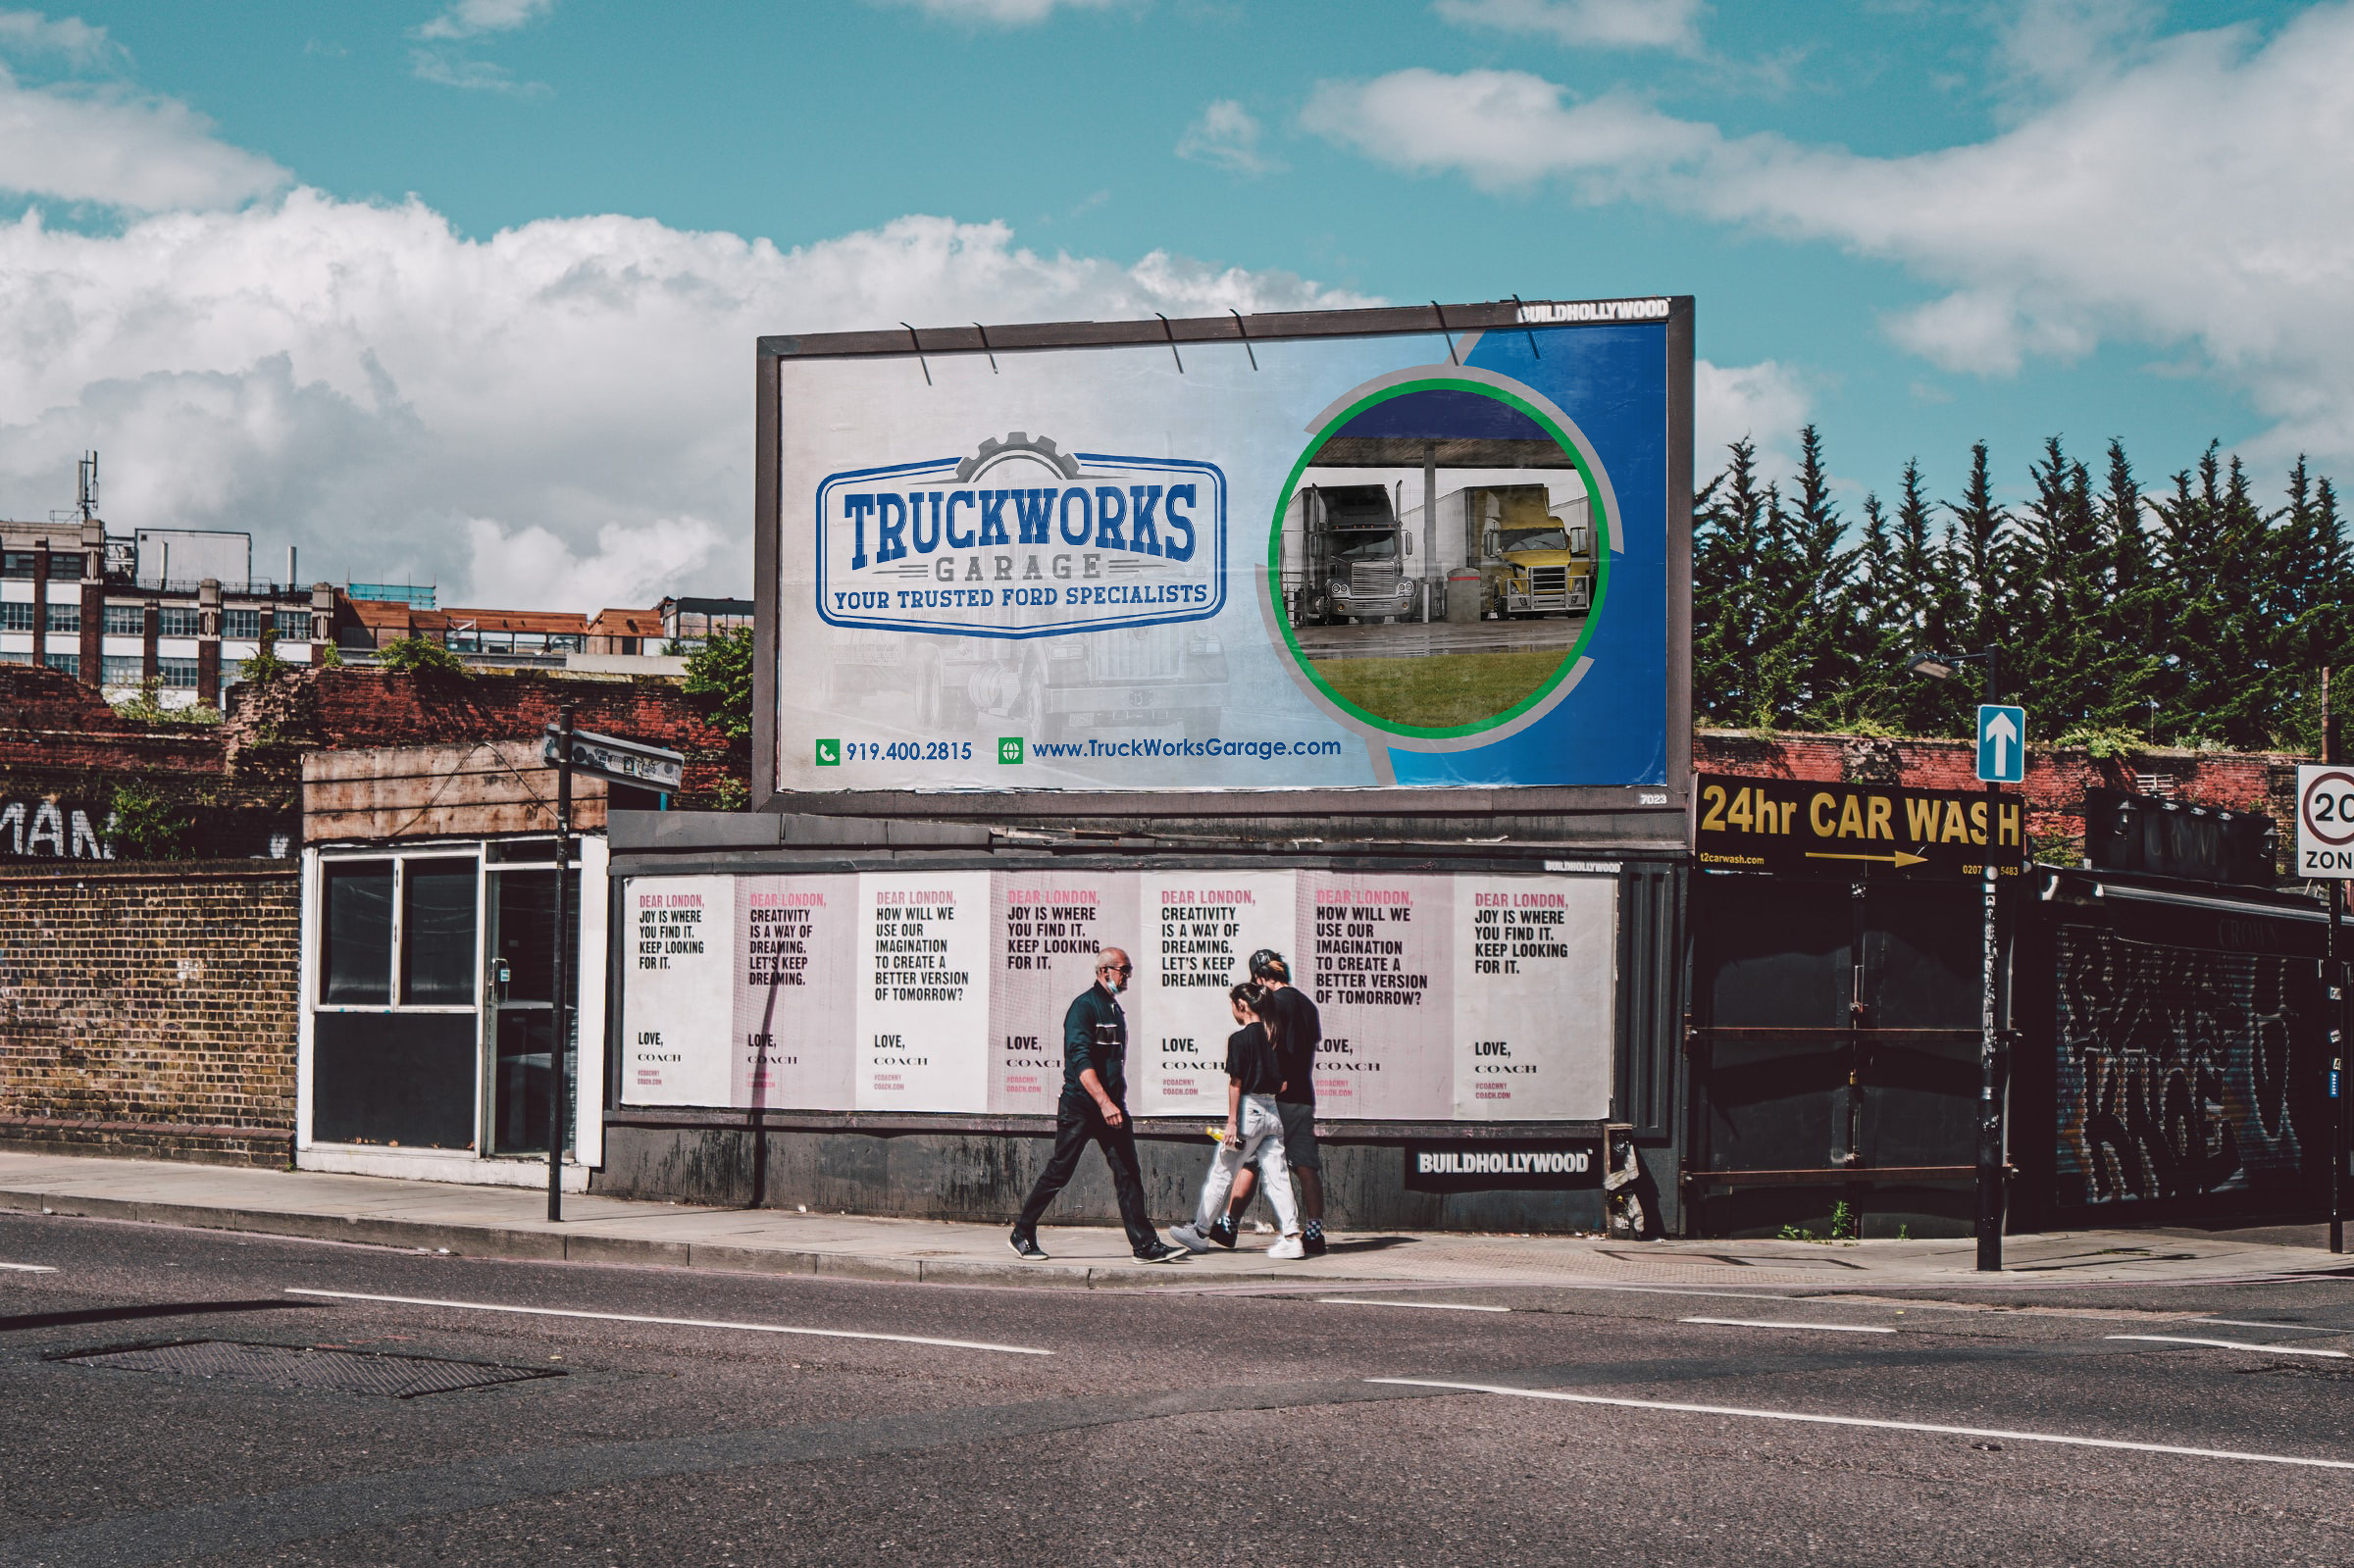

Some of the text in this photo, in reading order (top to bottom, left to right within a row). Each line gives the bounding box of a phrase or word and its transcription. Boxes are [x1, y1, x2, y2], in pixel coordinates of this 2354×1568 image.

[844, 483, 1197, 571] TRUCKWORKS
[936, 553, 1101, 582] GARAGE
[835, 584, 1207, 609] YOUR TRUSTED FORD SPECIALISTS
[846, 741, 972, 761] 919.400.2815
[1032, 737, 1342, 761] www.TruckWorksGarage.com
[1640, 794, 1667, 805] 7023
[2315, 792, 2354, 823] 20
[1702, 785, 2020, 846] 24hr CAR WASH
[1545, 860, 1621, 873] BUILDHOLLYWOOD
[1963, 864, 1982, 875] 0207
[640, 894, 705, 910] DEAR LONDON,
[750, 893, 827, 908] DEAR LONDON,
[877, 890, 957, 907] DEAR LONDON,
[1008, 889, 1100, 907] DEAR LONDON,
[1161, 889, 1256, 907] DEAR LONDON,
[1317, 889, 1413, 907] DEAR LONDON,
[1475, 893, 1569, 910] DEAR LONDON,
[640, 910, 702, 923] JOY IS WHERE
[750, 909, 810, 922] CREATIVITY
[876, 907, 954, 921] HOW WILL WE
[1007, 907, 1097, 920] JOY IS WHERE
[1161, 907, 1236, 921] CREATIVITY
[1316, 906, 1410, 922] HOW WILL WE
[1474, 910, 1564, 925] JOY IS WHERE
[640, 926, 694, 938] YOU FIND IT.
[749, 925, 813, 938] IS A WAY OF
[876, 923, 924, 936] USE OUR
[1007, 923, 1086, 936] YOU FIND IT.
[1161, 924, 1240, 937] IS A WAY OF
[1316, 923, 1374, 937] USE OUR
[1474, 927, 1554, 941] YOU FIND IT.
[640, 941, 704, 953] KEEP LOOKING
[749, 940, 806, 954] DREAMING.
[876, 939, 947, 953] IMAGINATION
[1008, 939, 1100, 953] KEEP LOOKING
[1162, 940, 1233, 954] DREAMING.
[1316, 940, 1403, 955] IMAGINATION
[1475, 943, 1568, 958] KEEP LOOKING
[640, 957, 670, 969] FOR IT.
[782, 956, 808, 970] KEEP
[875, 955, 947, 969] TO CREATE A
[1007, 956, 1051, 970] FOR IT.
[1162, 956, 1236, 971] LET'S KEEP
[1315, 956, 1401, 972] TO CREATE A
[1475, 960, 1520, 974] FOR IT.
[749, 972, 806, 986] DREAMING.
[875, 972, 969, 985] BETTER VERSION
[1162, 973, 1233, 987] DREAMING.
[1316, 973, 1427, 989] BETTER VERSION
[875, 987, 963, 1001] OF TOMORROW?
[1315, 989, 1422, 1005] OF TOMORROW?
[638, 1032, 664, 1048] LOVE,
[747, 1034, 777, 1050] LOVE,
[874, 1035, 905, 1051] LOVE,
[1006, 1036, 1042, 1052] LOVE,
[1162, 1037, 1199, 1055] LOVE,
[1474, 1041, 1511, 1059] LOVE,
[638, 1053, 682, 1062] COACH
[747, 1055, 797, 1064] COACH
[874, 1057, 928, 1066] COACH
[1161, 1061, 1225, 1070] COACH
[1315, 1062, 1380, 1072] COACH
[1474, 1065, 1537, 1074] COACH
[1419, 1152, 1589, 1173] BUILDHOLLYWOOD
